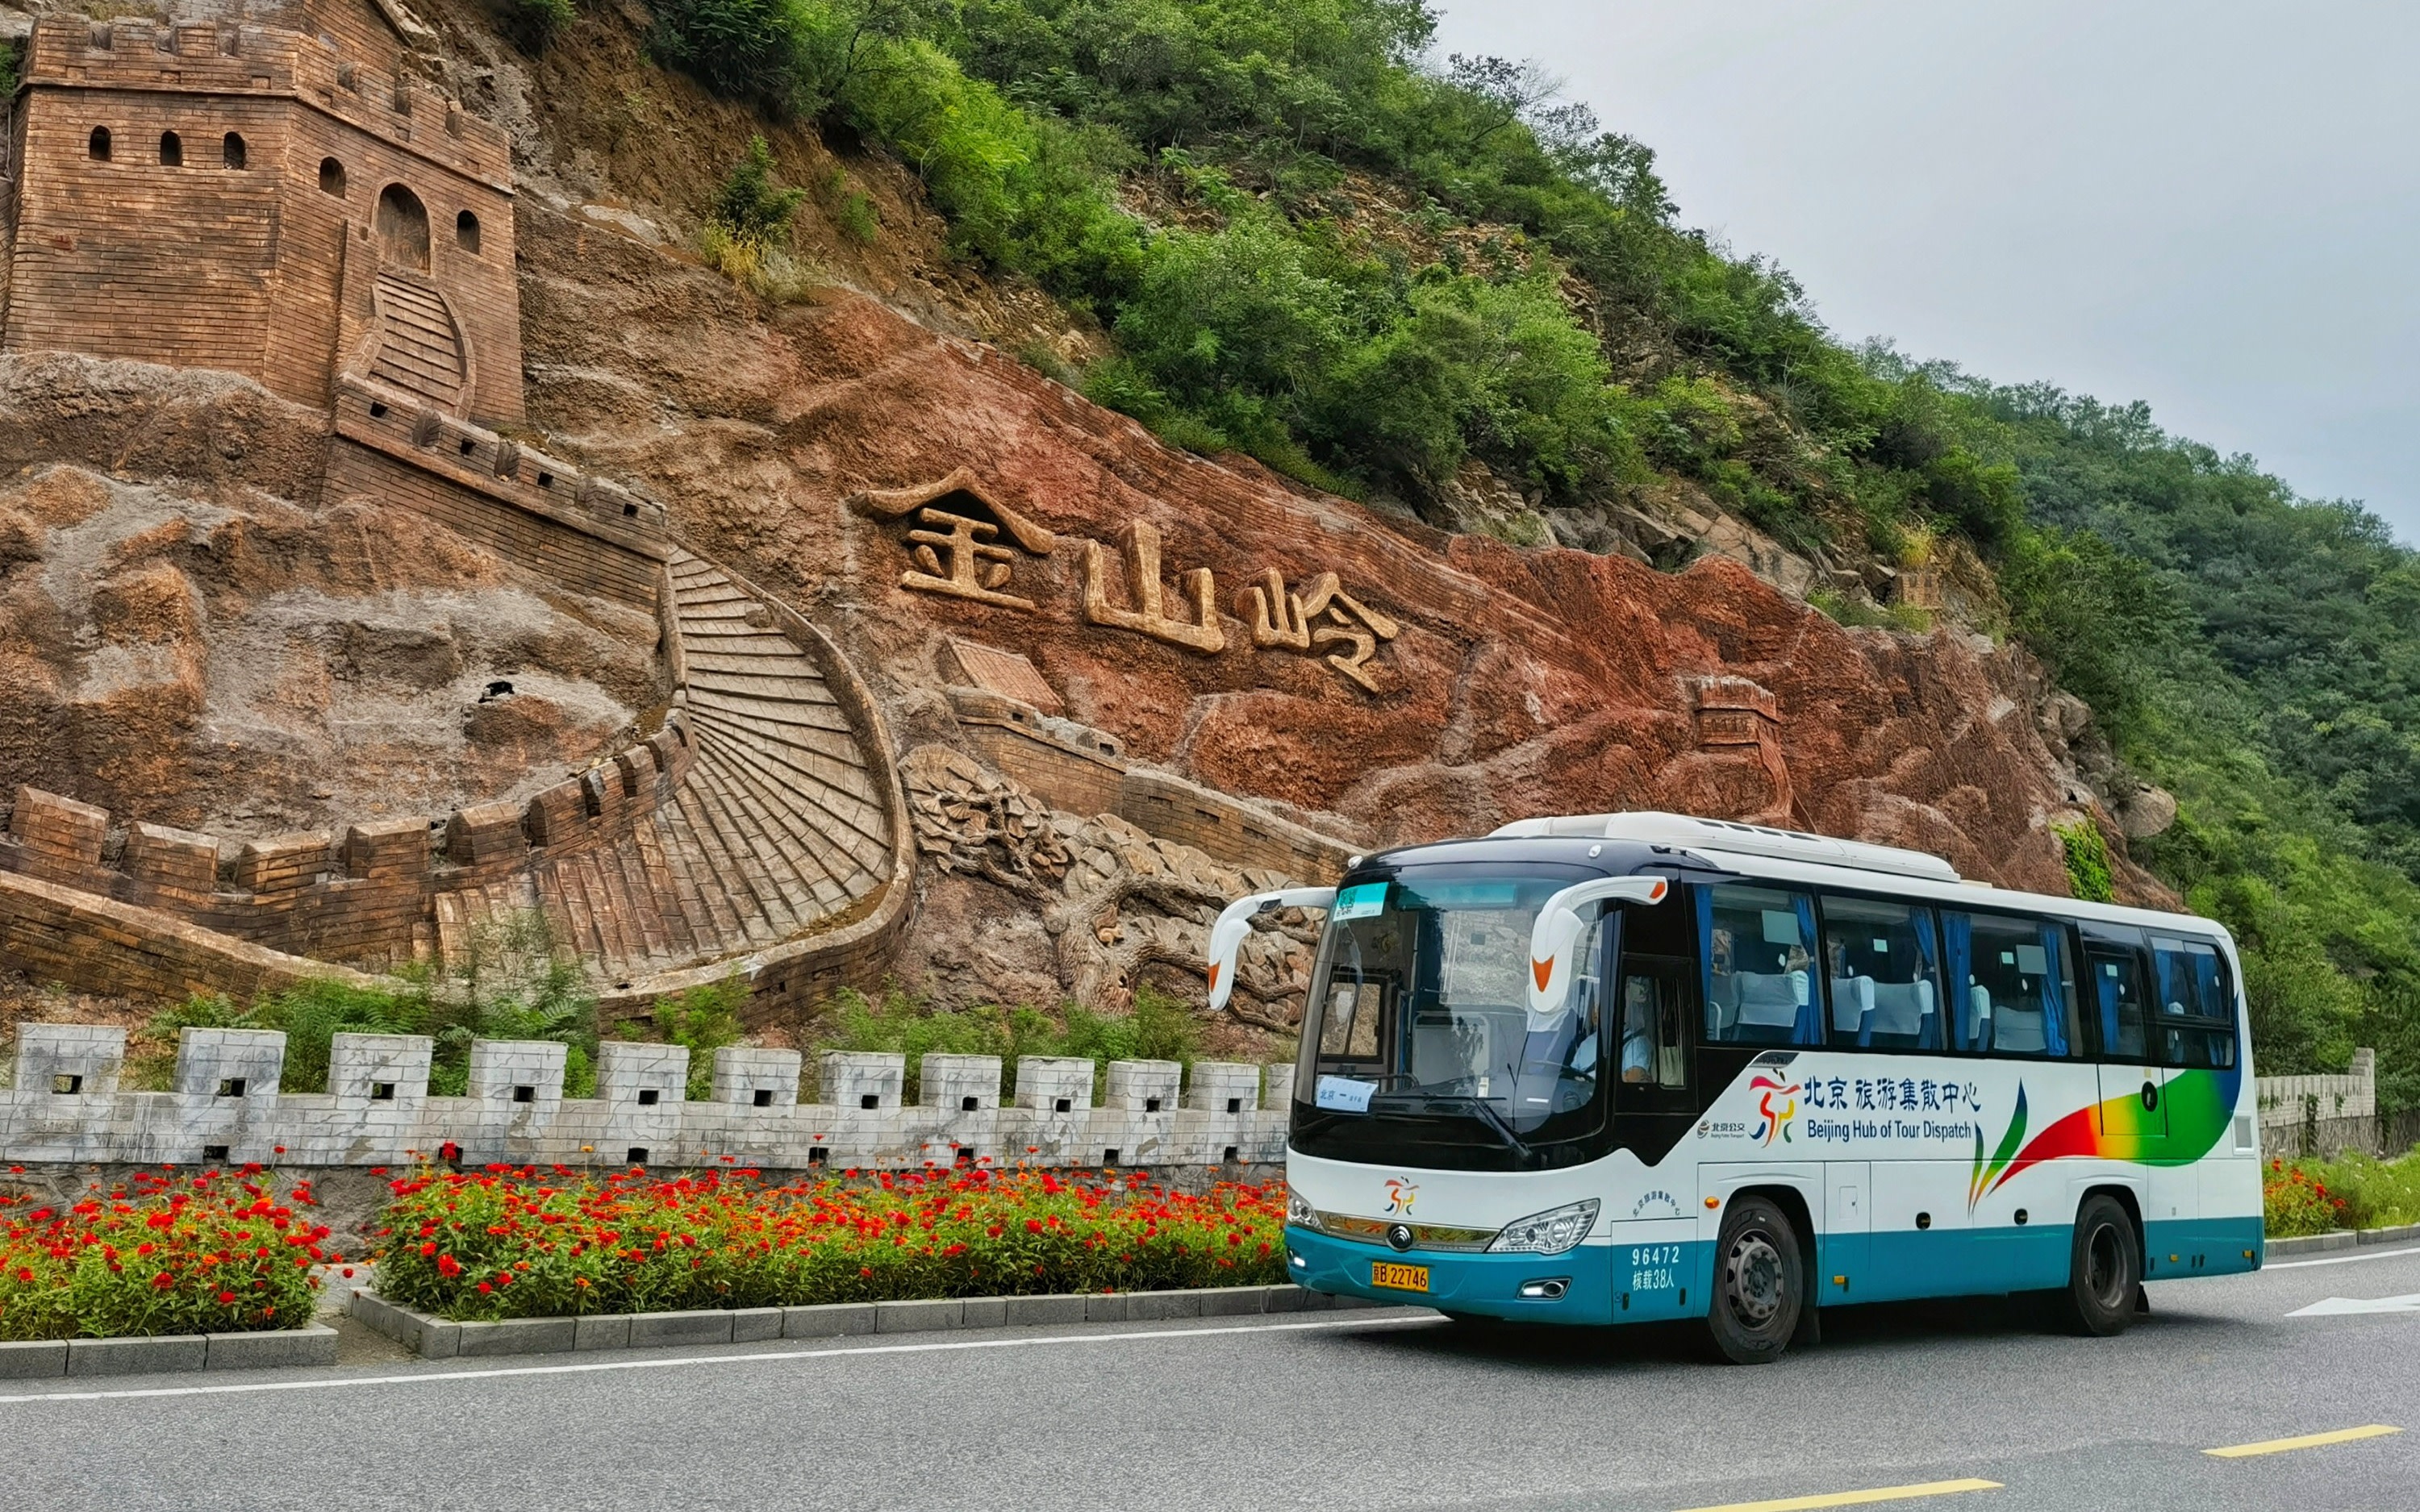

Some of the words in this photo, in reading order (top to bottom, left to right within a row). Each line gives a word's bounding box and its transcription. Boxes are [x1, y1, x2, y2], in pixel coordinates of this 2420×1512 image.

[845, 465, 1399, 694] 金山岭
[1808, 1119, 1849, 1143] Beijing
[1853, 1120, 1877, 1138] Hub
[1880, 1120, 1892, 1138] of
[1895, 1120, 1920, 1139] Tour
[1923, 1121, 1971, 1143] Dispatch
[1632, 1246, 1679, 1265] 96472
[1632, 1268, 1675, 1291] 核载38人
